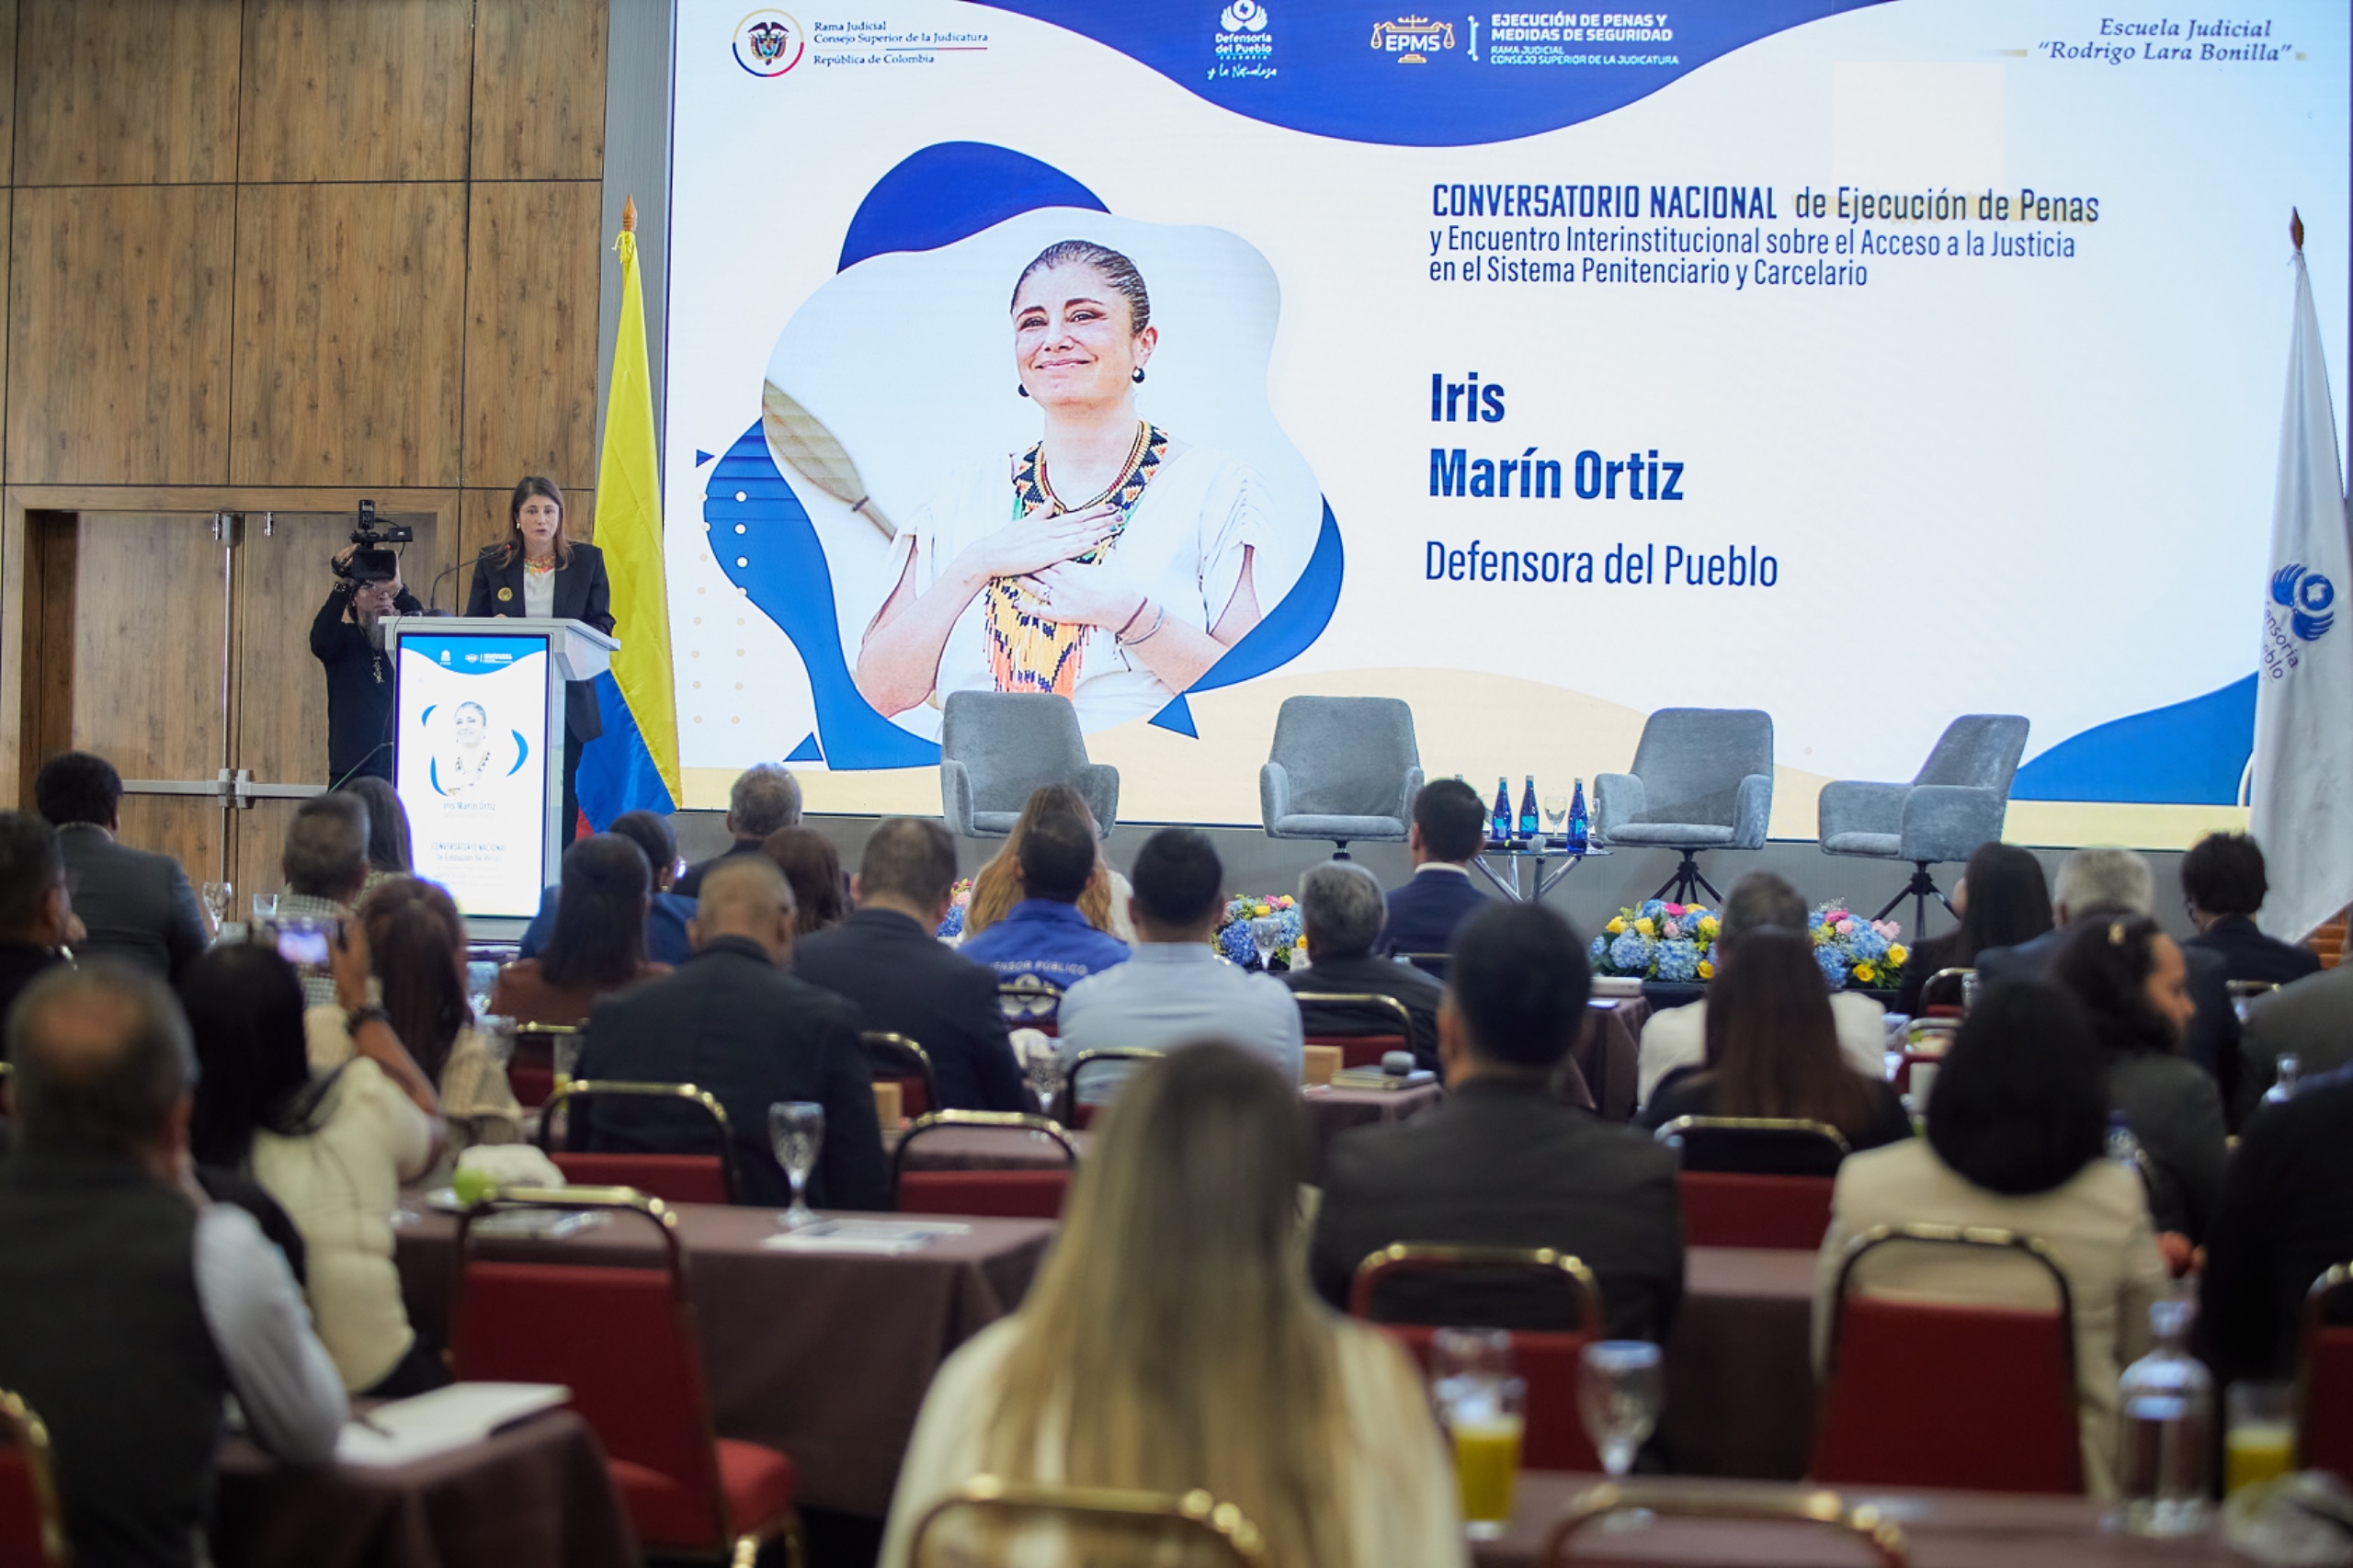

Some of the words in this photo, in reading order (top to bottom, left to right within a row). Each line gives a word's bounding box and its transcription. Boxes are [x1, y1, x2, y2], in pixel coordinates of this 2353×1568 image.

[814, 21, 845, 31] Rama
[847, 21, 886, 32] Judicial
[1492, 11, 1576, 27] EJECUCIÓN
[1580, 14, 1600, 27] DE
[1603, 14, 1654, 27] PENAS
[1655, 14, 1667, 27] Y
[1491, 28, 1560, 41] MEDIDAS
[1563, 28, 1583, 41] DE
[1586, 28, 1673, 41] SEGURIDAD
[2099, 17, 2180, 36] Escuela
[2185, 18, 2272, 41] Judicial
[813, 34, 856, 45] Consejo
[858, 34, 904, 46] Superior
[905, 32, 919, 42] de
[921, 32, 931, 41] la
[933, 31, 988, 43] Judicatura
[1385, 34, 1441, 51] EPMS
[1215, 43, 1233, 53] del
[1234, 43, 1272, 53] Pueblo
[1491, 46, 1519, 54] RAMA
[1520, 46, 1564, 55] JUDICIAL
[2143, 42, 2193, 61] Lara
[813, 54, 866, 67] República
[868, 54, 881, 64] de
[882, 53, 935, 64] Colombia
[1491, 55, 1537, 64] CONSEJO
[1538, 55, 1586, 64] SUPERIOR
[1587, 55, 1601, 64] DE
[1603, 55, 1616, 64] LA
[1617, 55, 1679, 64] JUDICATURA
[1432, 184, 1640, 218] CONVERSATORIO
[1650, 185, 1778, 220] NACIONAL
[1795, 186, 1826, 219] de
[1837, 186, 1967, 225] Ejecución
[1978, 187, 2009, 221] de
[2020, 187, 2099, 222] Penas
[1429, 230, 1442, 256] y
[1449, 224, 1561, 252] Encuentro
[1567, 225, 1760, 254] Interinstitucional
[1766, 227, 1829, 255] sobre
[1836, 228, 1854, 255] el
[1860, 229, 1940, 256] Acceso
[1947, 235, 1959, 256] a
[1966, 229, 1984, 256] la
[1991, 230, 2075, 257] Justicia
[1429, 260, 1456, 281] en
[1462, 255, 1482, 282] el
[1487, 256, 1574, 282] Sistema
[1582, 257, 1730, 284] Penitenciario
[1735, 264, 1748, 291] y
[1754, 258, 1868, 287] Carcelario
[1430, 371, 1506, 424] Iris
[1429, 446, 1562, 499] Marín
[1574, 449, 1685, 501] Ortiz
[1426, 540, 1594, 584] Defensora
[1604, 542, 1654, 585] del
[1665, 544, 1779, 587] Pueblo
